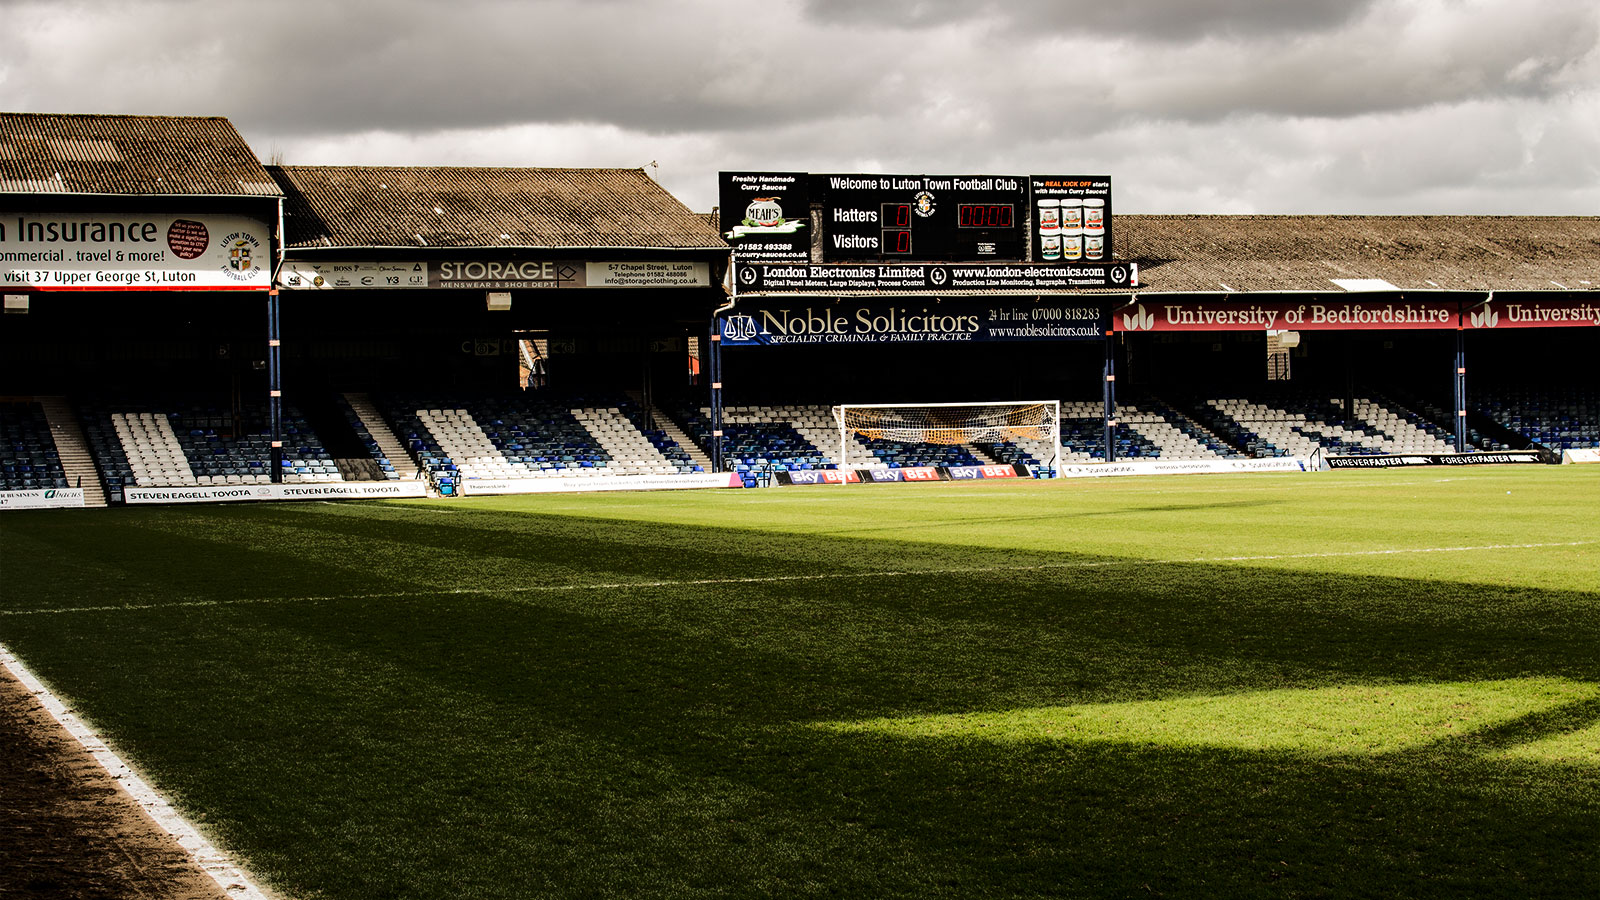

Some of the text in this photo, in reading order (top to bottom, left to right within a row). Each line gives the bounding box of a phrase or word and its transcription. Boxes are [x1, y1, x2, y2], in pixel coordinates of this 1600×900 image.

[830, 178, 1017, 190] Welcome to Luton Town Football Club
[748, 208, 780, 220] MEAH'S
[834, 208, 878, 222] Hatters
[897, 206, 908, 226] 0
[961, 206, 1012, 226] 00:00
[18, 217, 158, 242] Insurance
[220, 232, 260, 248] LUTON TOWN
[833, 234, 878, 248] Visitors
[897, 232, 909, 252] 0
[76, 250, 112, 262] travel
[116, 251, 124, 262] &
[128, 250, 165, 262] more!
[220, 264, 261, 281] FOOTBALL CLUB
[440, 262, 554, 280] STORAGE
[620, 264, 645, 272] Chapel
[646, 264, 670, 272] Street,
[763, 266, 924, 278] London Electronics Limited
[952, 266, 1104, 278] www.london-electronics.com
[4, 270, 196, 284] visit 37 Upper George St, Luton
[604, 277, 698, 285] info@storageclothing.co.uk
[1000, 279, 1034, 287] Monitoring,
[1068, 278, 1105, 286] Transmitters
[830, 280, 847, 288] Large
[848, 280, 876, 288] Displays,
[760, 307, 980, 335] Noble Solicitors
[988, 308, 1100, 321] 24 hr line 07000 818283
[1164, 304, 1449, 329] University of Bedfordshire
[989, 323, 1100, 337] www.noblesolicitors.co.uk
[770, 333, 972, 344] SPECIALIST CRIMINAL & FAMILY PRACTICE
[792, 470, 854, 483] sky BET
[874, 468, 933, 481] sky BET
[951, 466, 1011, 480] sky BET
[130, 490, 170, 500] STEVEN
[172, 490, 210, 499] EAGELL
[212, 489, 251, 498] TOYOTA
[284, 486, 400, 496] STEVEN EAGELL TOYOTA
